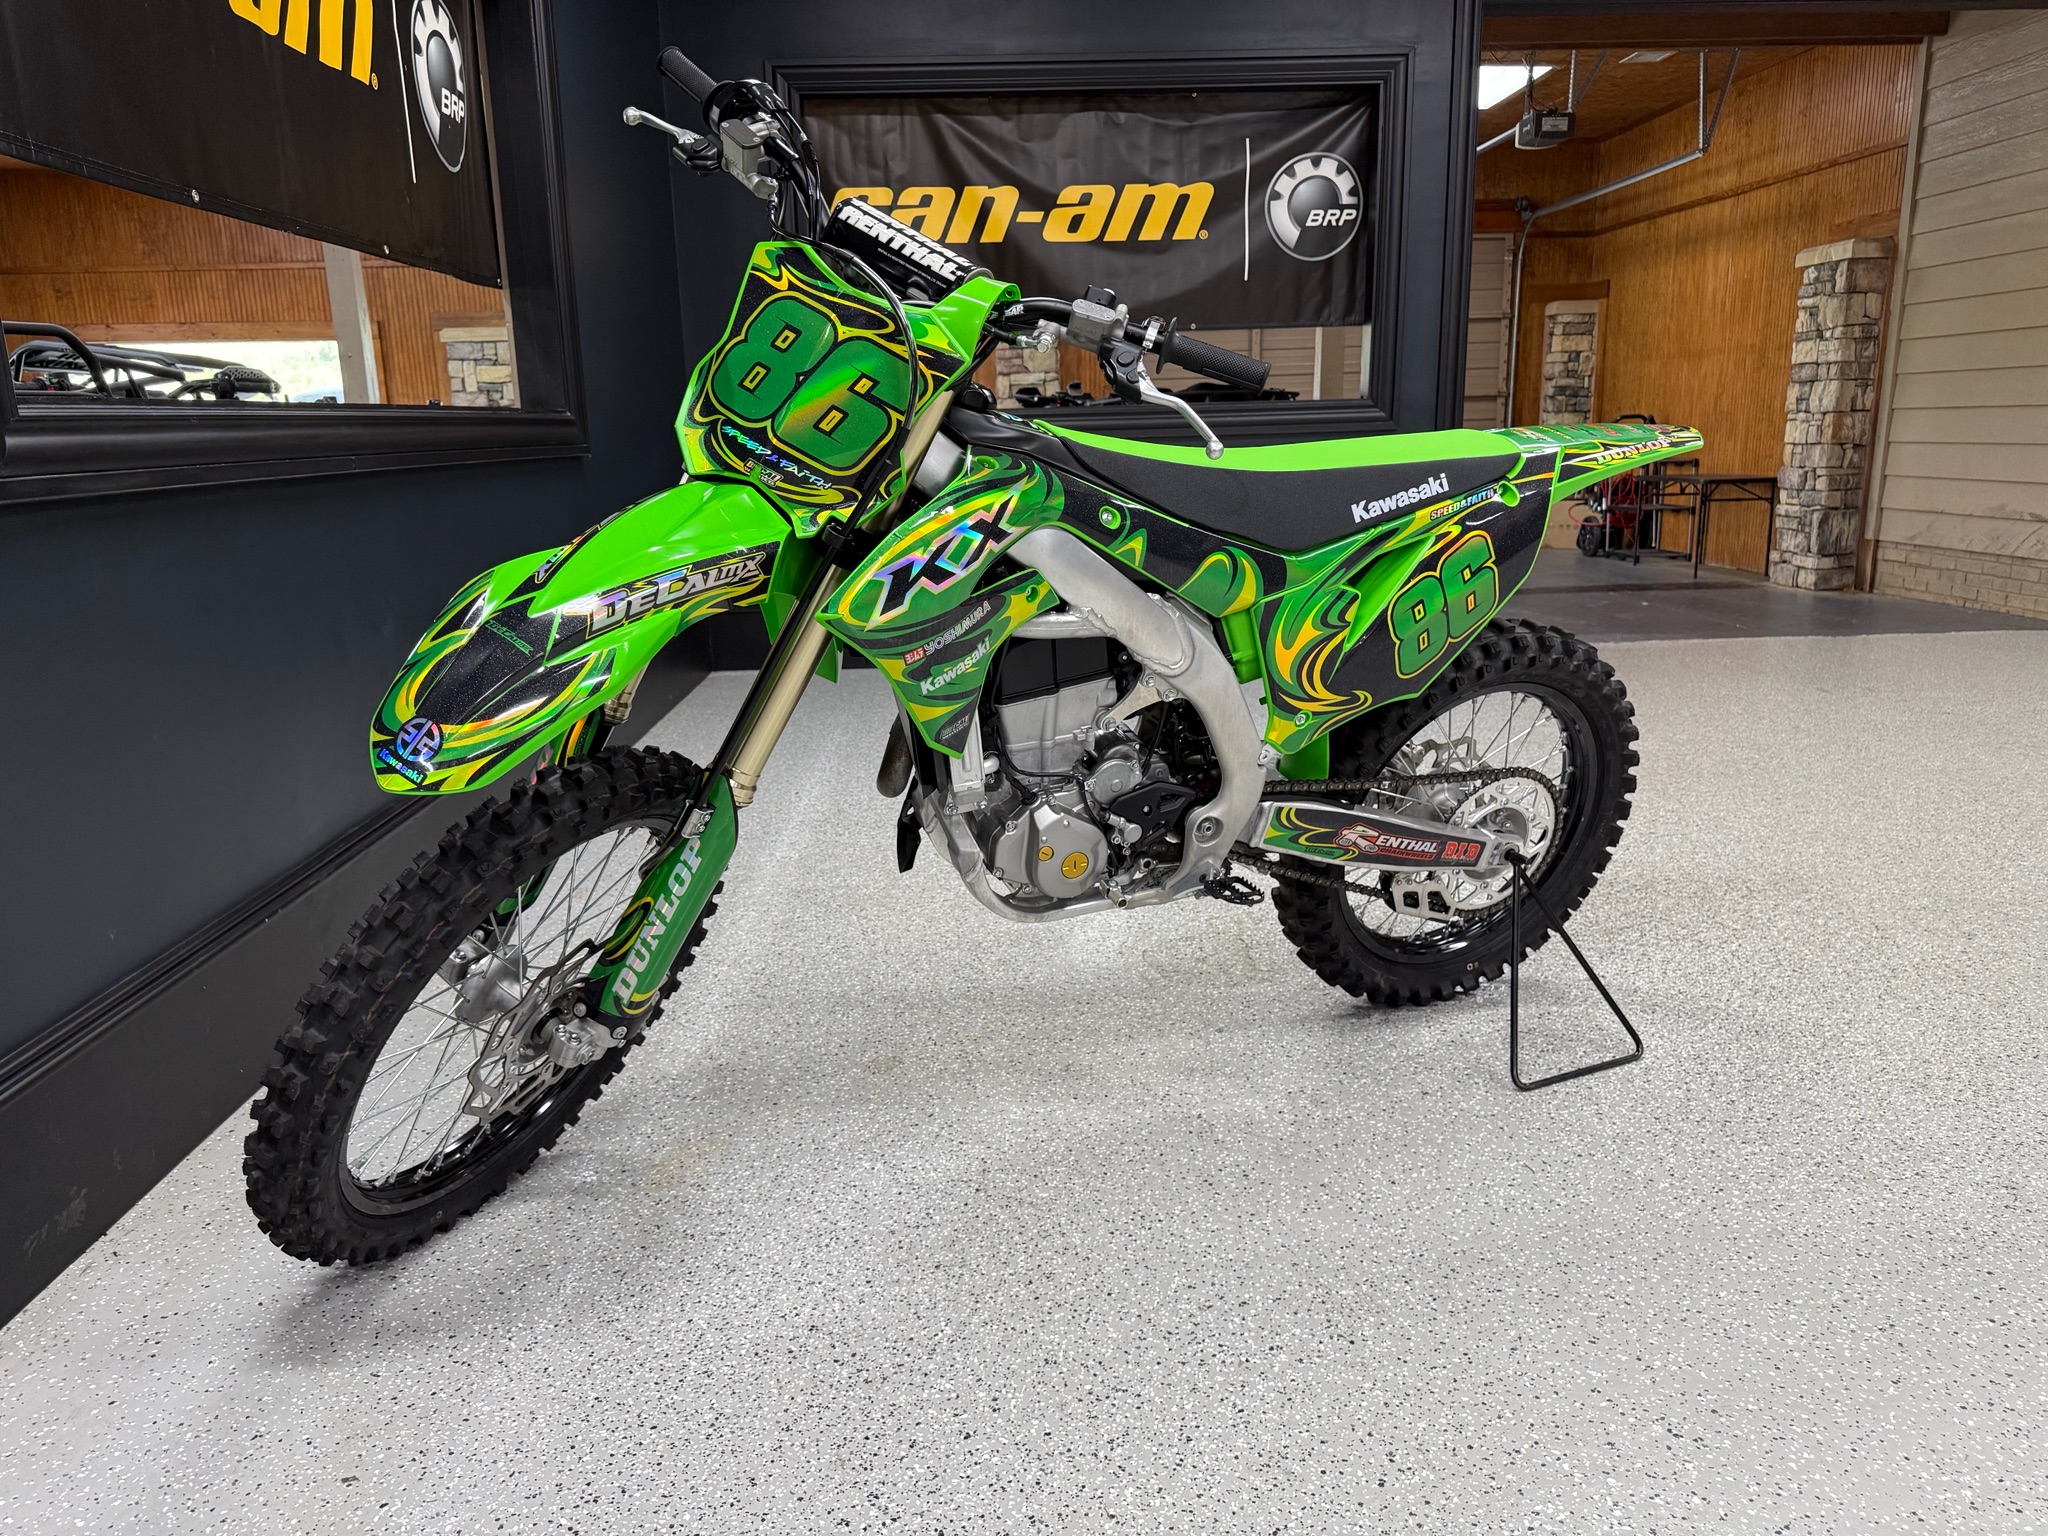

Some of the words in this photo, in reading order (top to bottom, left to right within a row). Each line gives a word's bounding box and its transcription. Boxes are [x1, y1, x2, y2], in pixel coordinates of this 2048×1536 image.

[441, 87, 465, 124] BRP
[837, 205, 961, 282] RENTHAL
[1305, 208, 1357, 227] BRP
[709, 297, 925, 470] 86
[1350, 472, 1450, 524] Kawasaki
[923, 599, 992, 656] YOSHIMURA
[1388, 531, 1499, 678] 86
[920, 635, 991, 695] Kawasaki
[379, 748, 424, 784] Kawasaki
[612, 837, 702, 1005] DUNLOP
